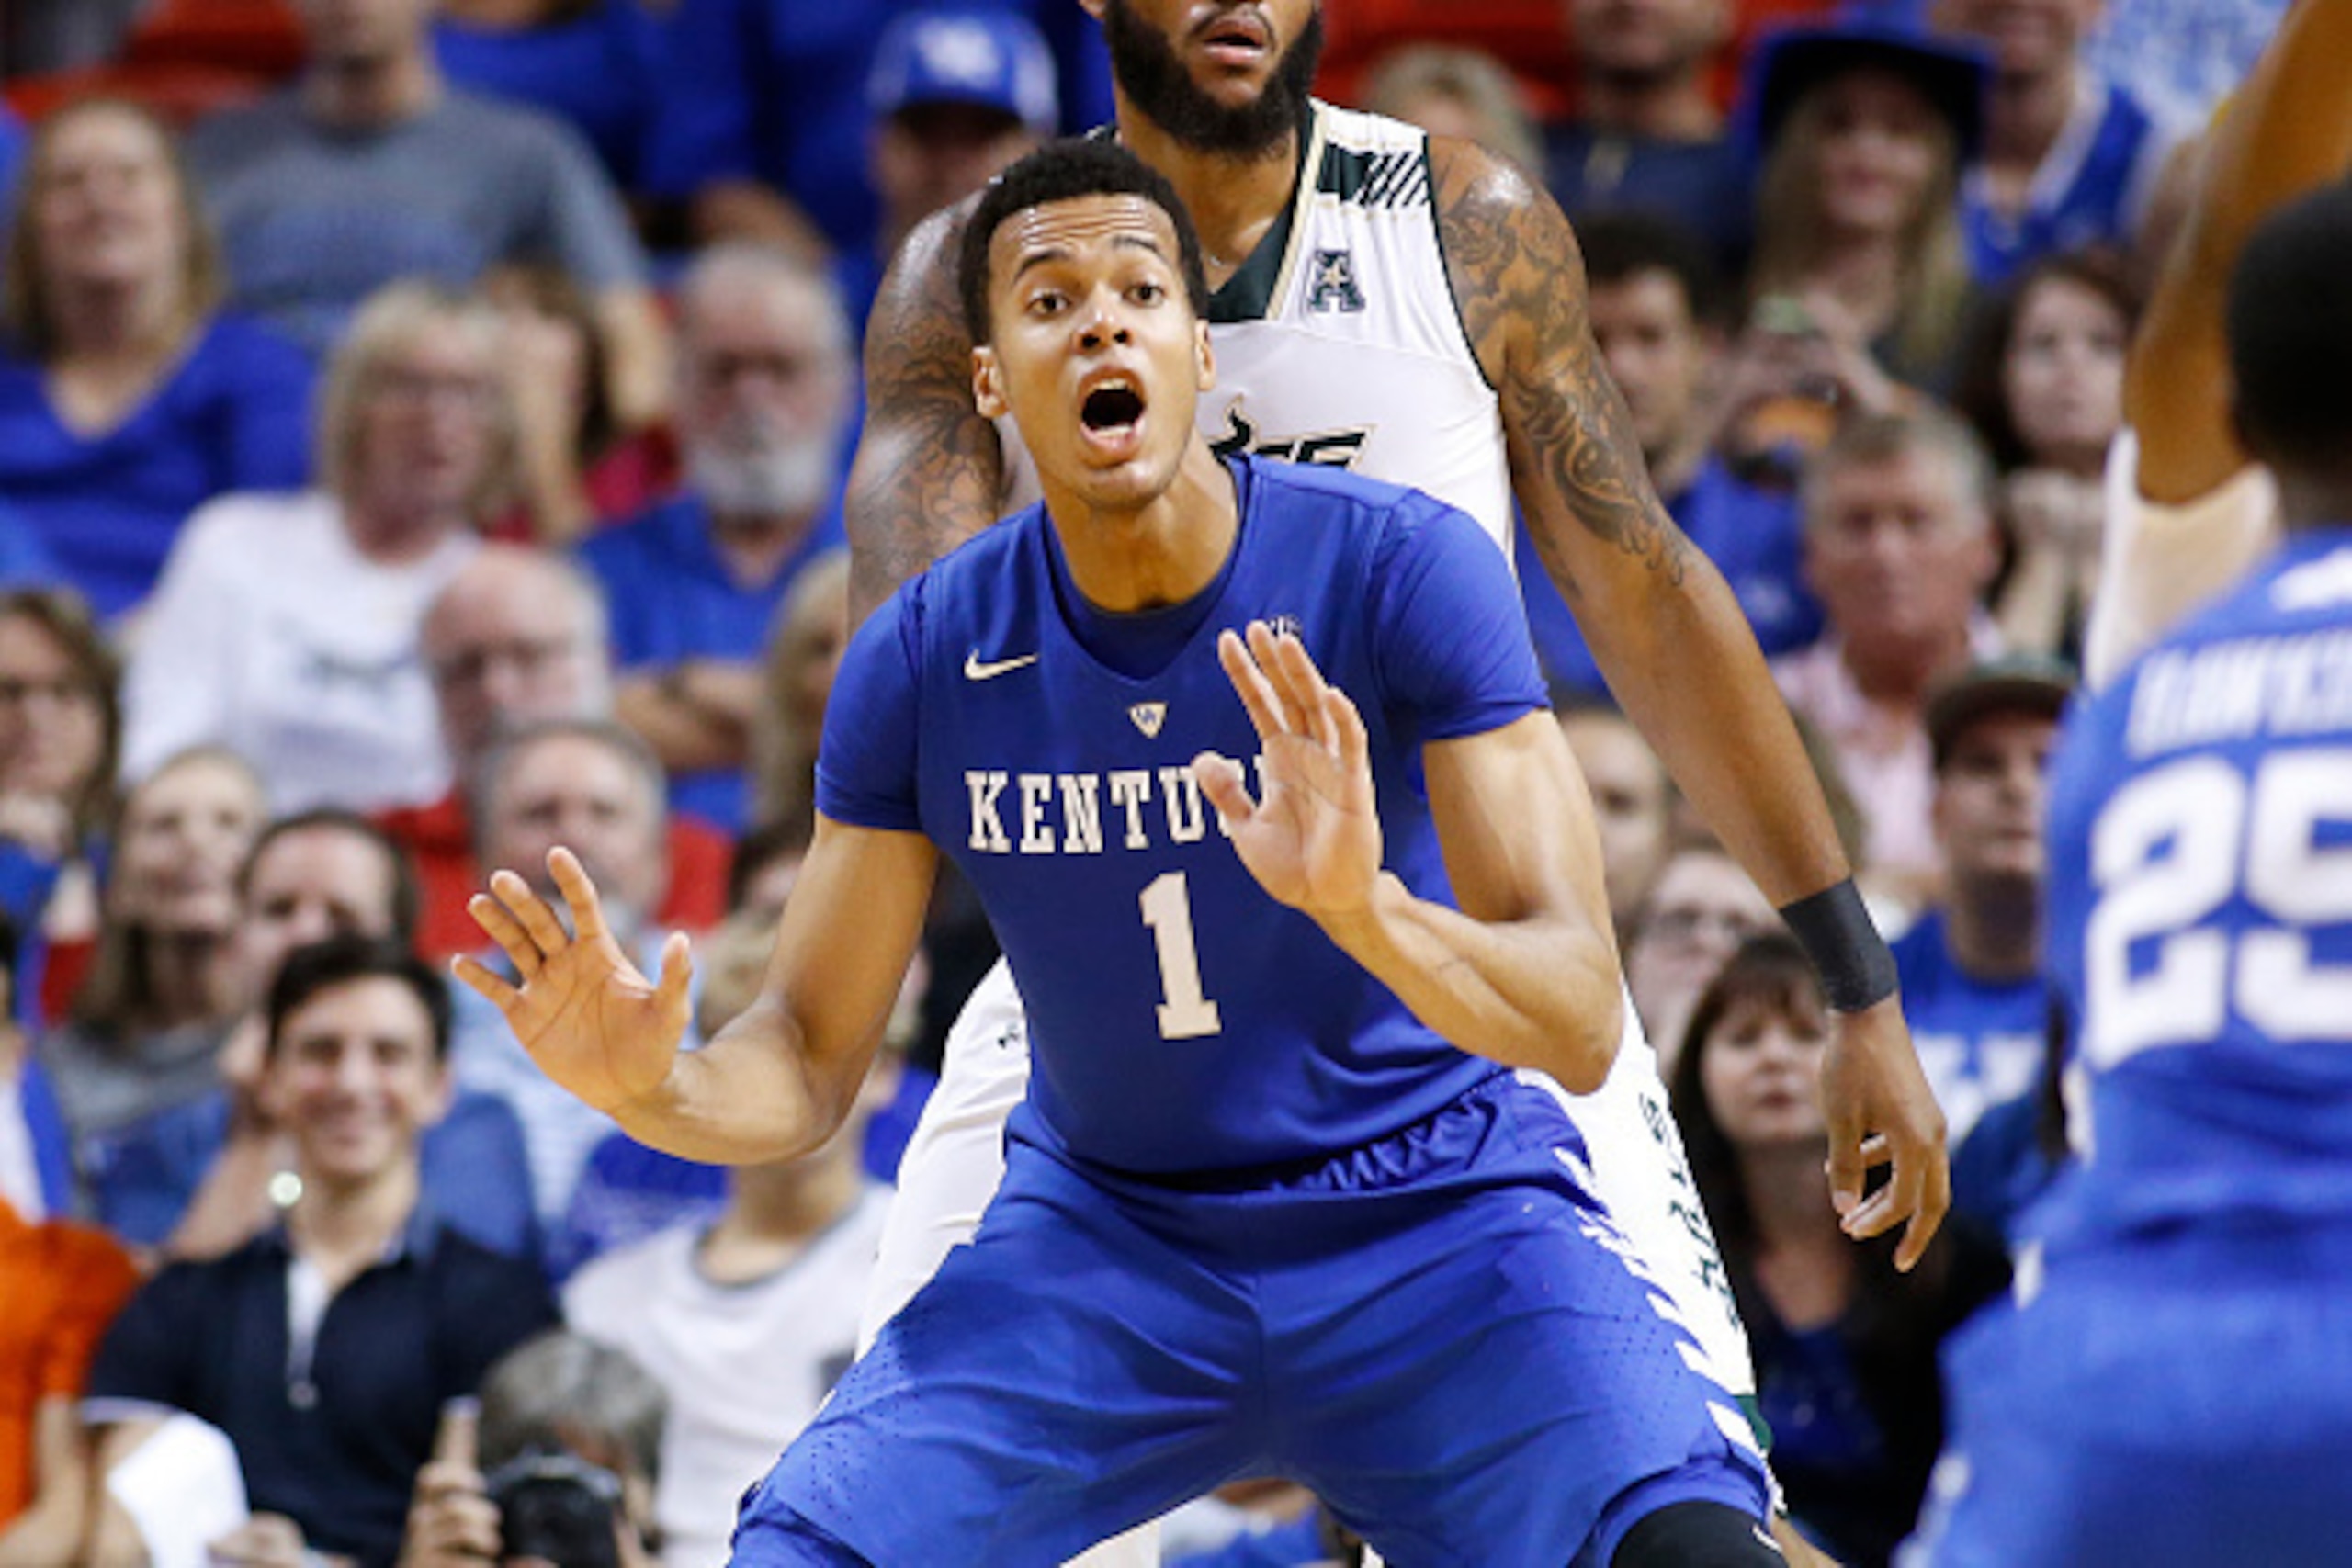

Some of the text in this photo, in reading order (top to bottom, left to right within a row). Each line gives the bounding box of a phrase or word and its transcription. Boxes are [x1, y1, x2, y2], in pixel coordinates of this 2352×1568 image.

[965, 755, 1263, 854] KENTU
[1138, 871, 1221, 1040] 1
[2082, 750, 2352, 1073] 25
